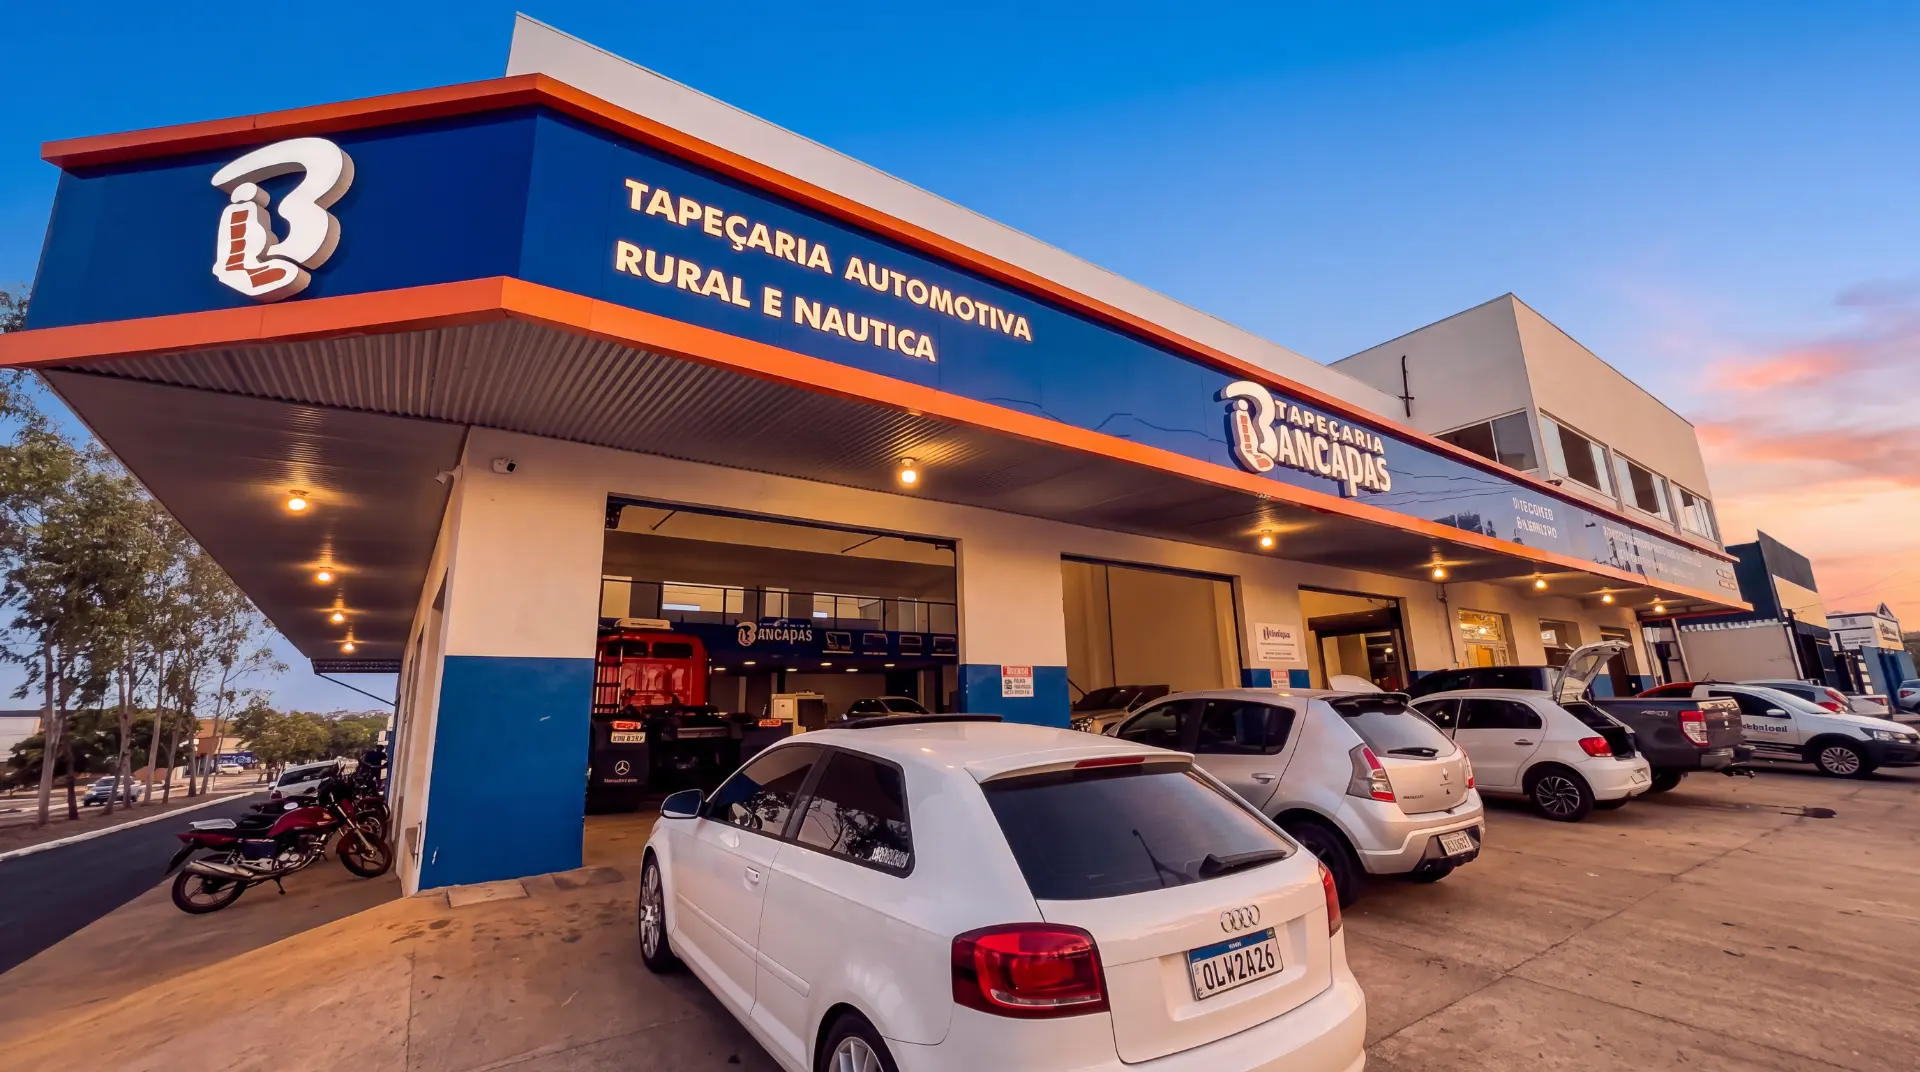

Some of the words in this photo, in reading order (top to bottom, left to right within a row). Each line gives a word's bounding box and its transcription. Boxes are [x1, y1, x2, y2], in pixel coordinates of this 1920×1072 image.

[615, 240, 751, 308] RURAL
[763, 286, 783, 318] E
[794, 295, 936, 362] NAUTICA
[624, 178, 833, 274] TAPEÇARIA
[845, 257, 1033, 341] AUTOMOTIVA
[1275, 400, 1385, 455] TAPEÇARIA
